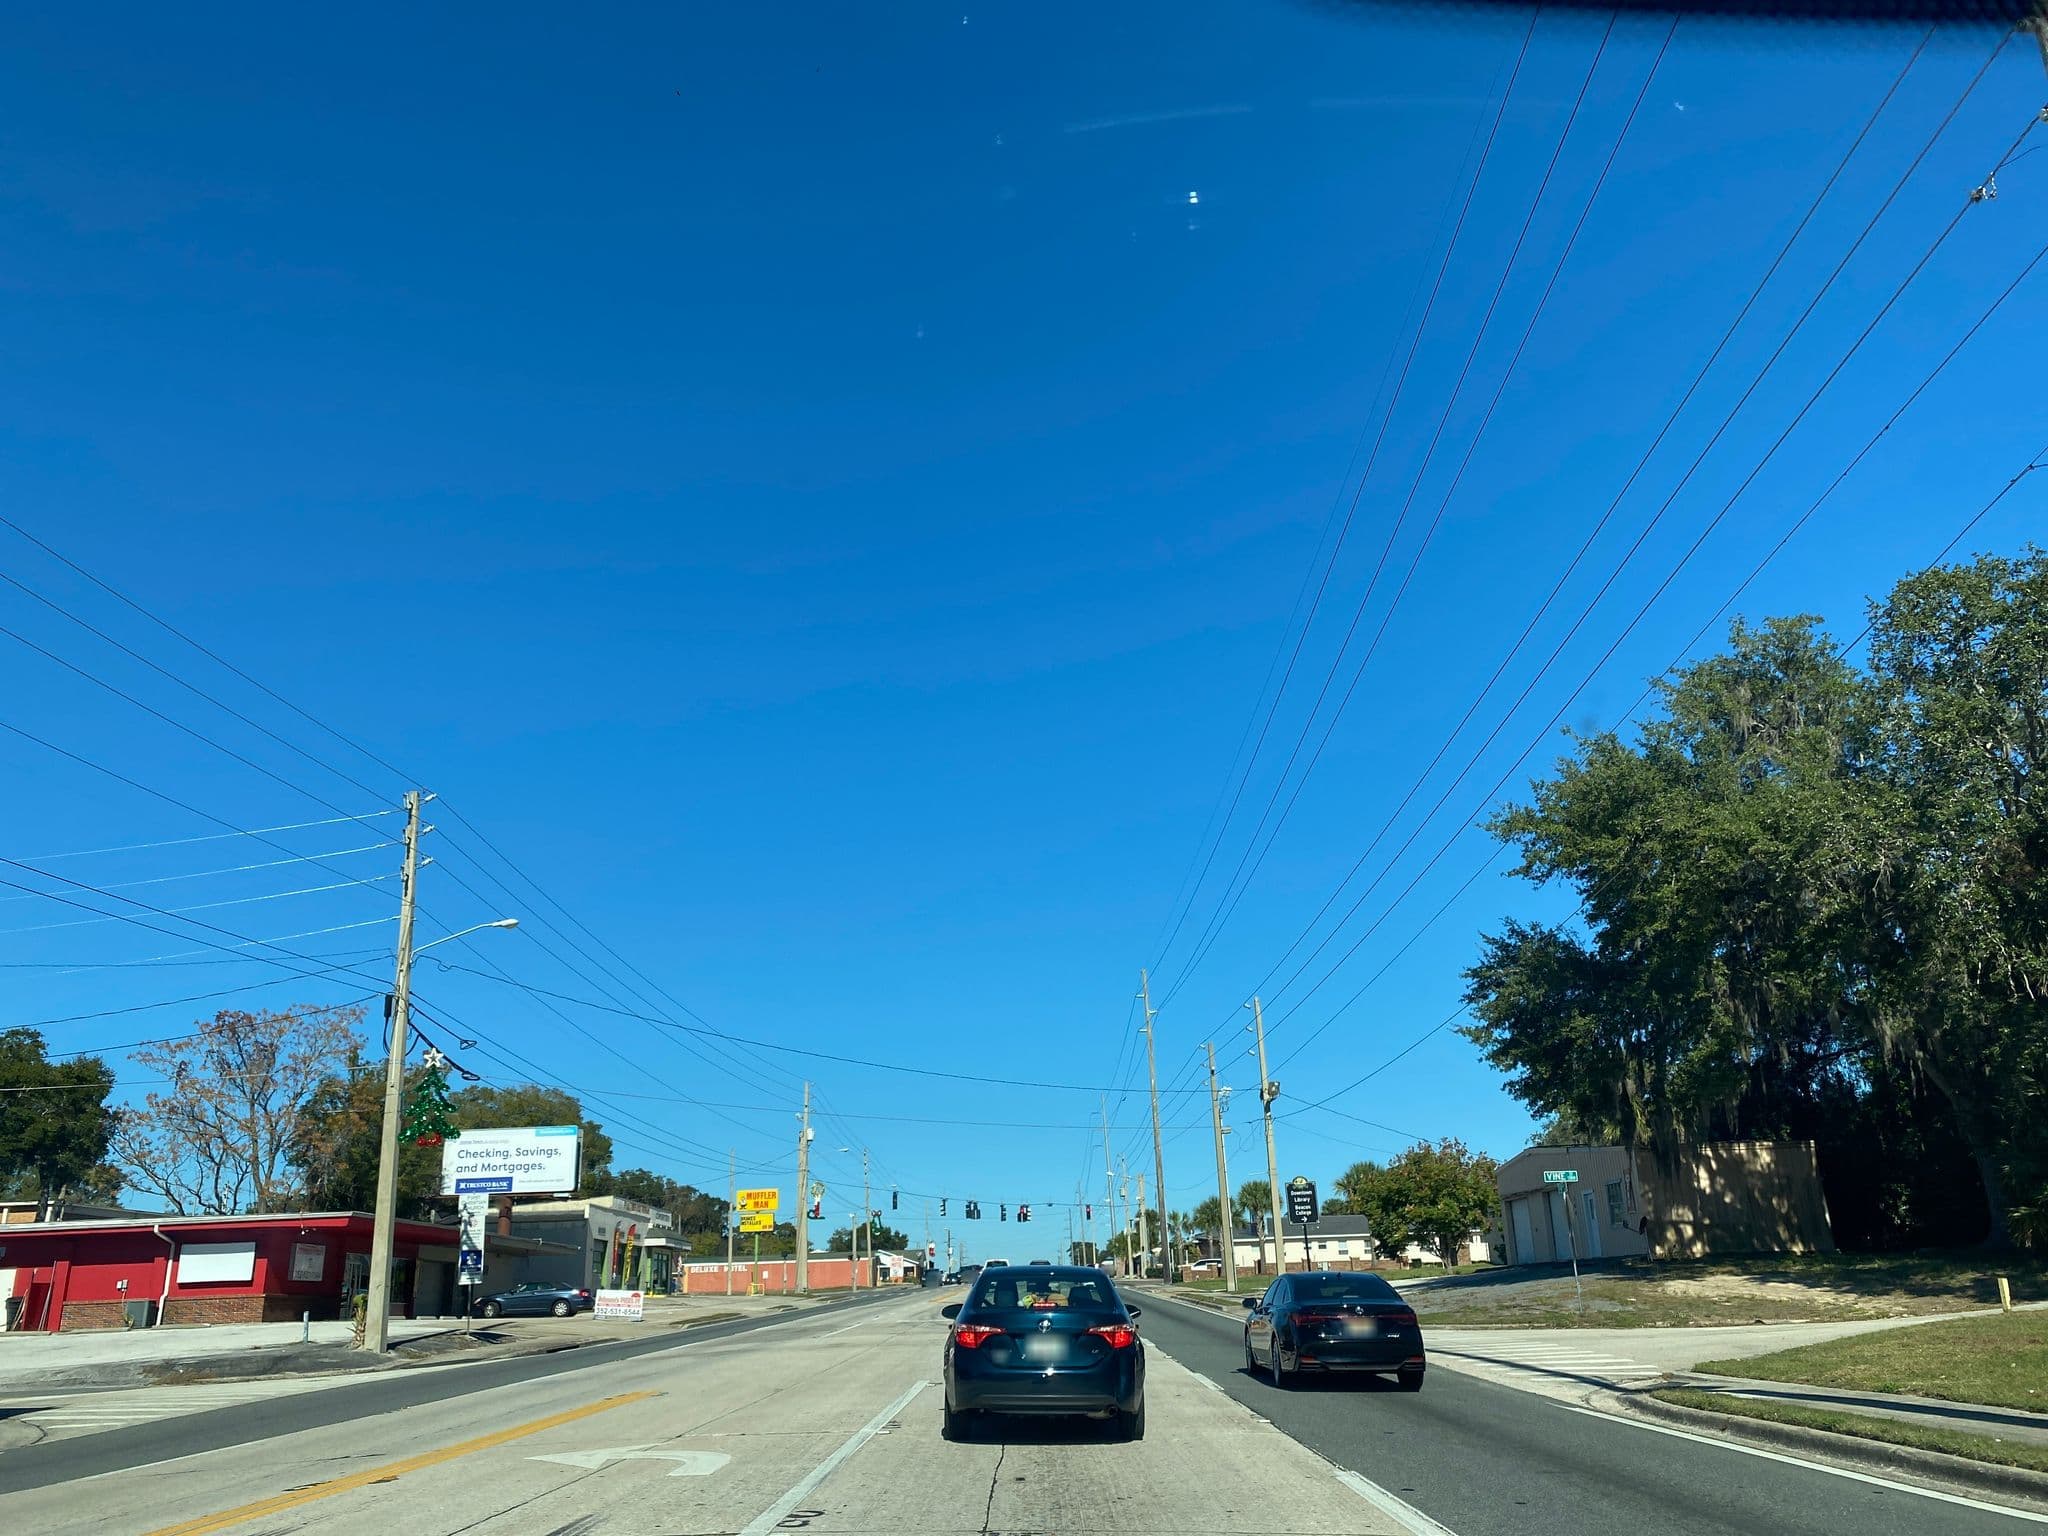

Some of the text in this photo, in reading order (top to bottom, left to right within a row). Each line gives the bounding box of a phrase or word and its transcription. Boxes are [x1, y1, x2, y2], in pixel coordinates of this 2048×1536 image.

[457, 1147, 562, 1159] Checking, Savings,
[456, 1162, 545, 1173] and Mortgages.
[1546, 1172, 1565, 1181] VINE
[746, 1192, 776, 1200] MUFFLER
[754, 1201, 769, 1209] MAN
[690, 1264, 748, 1273] DELUXE MTEL
